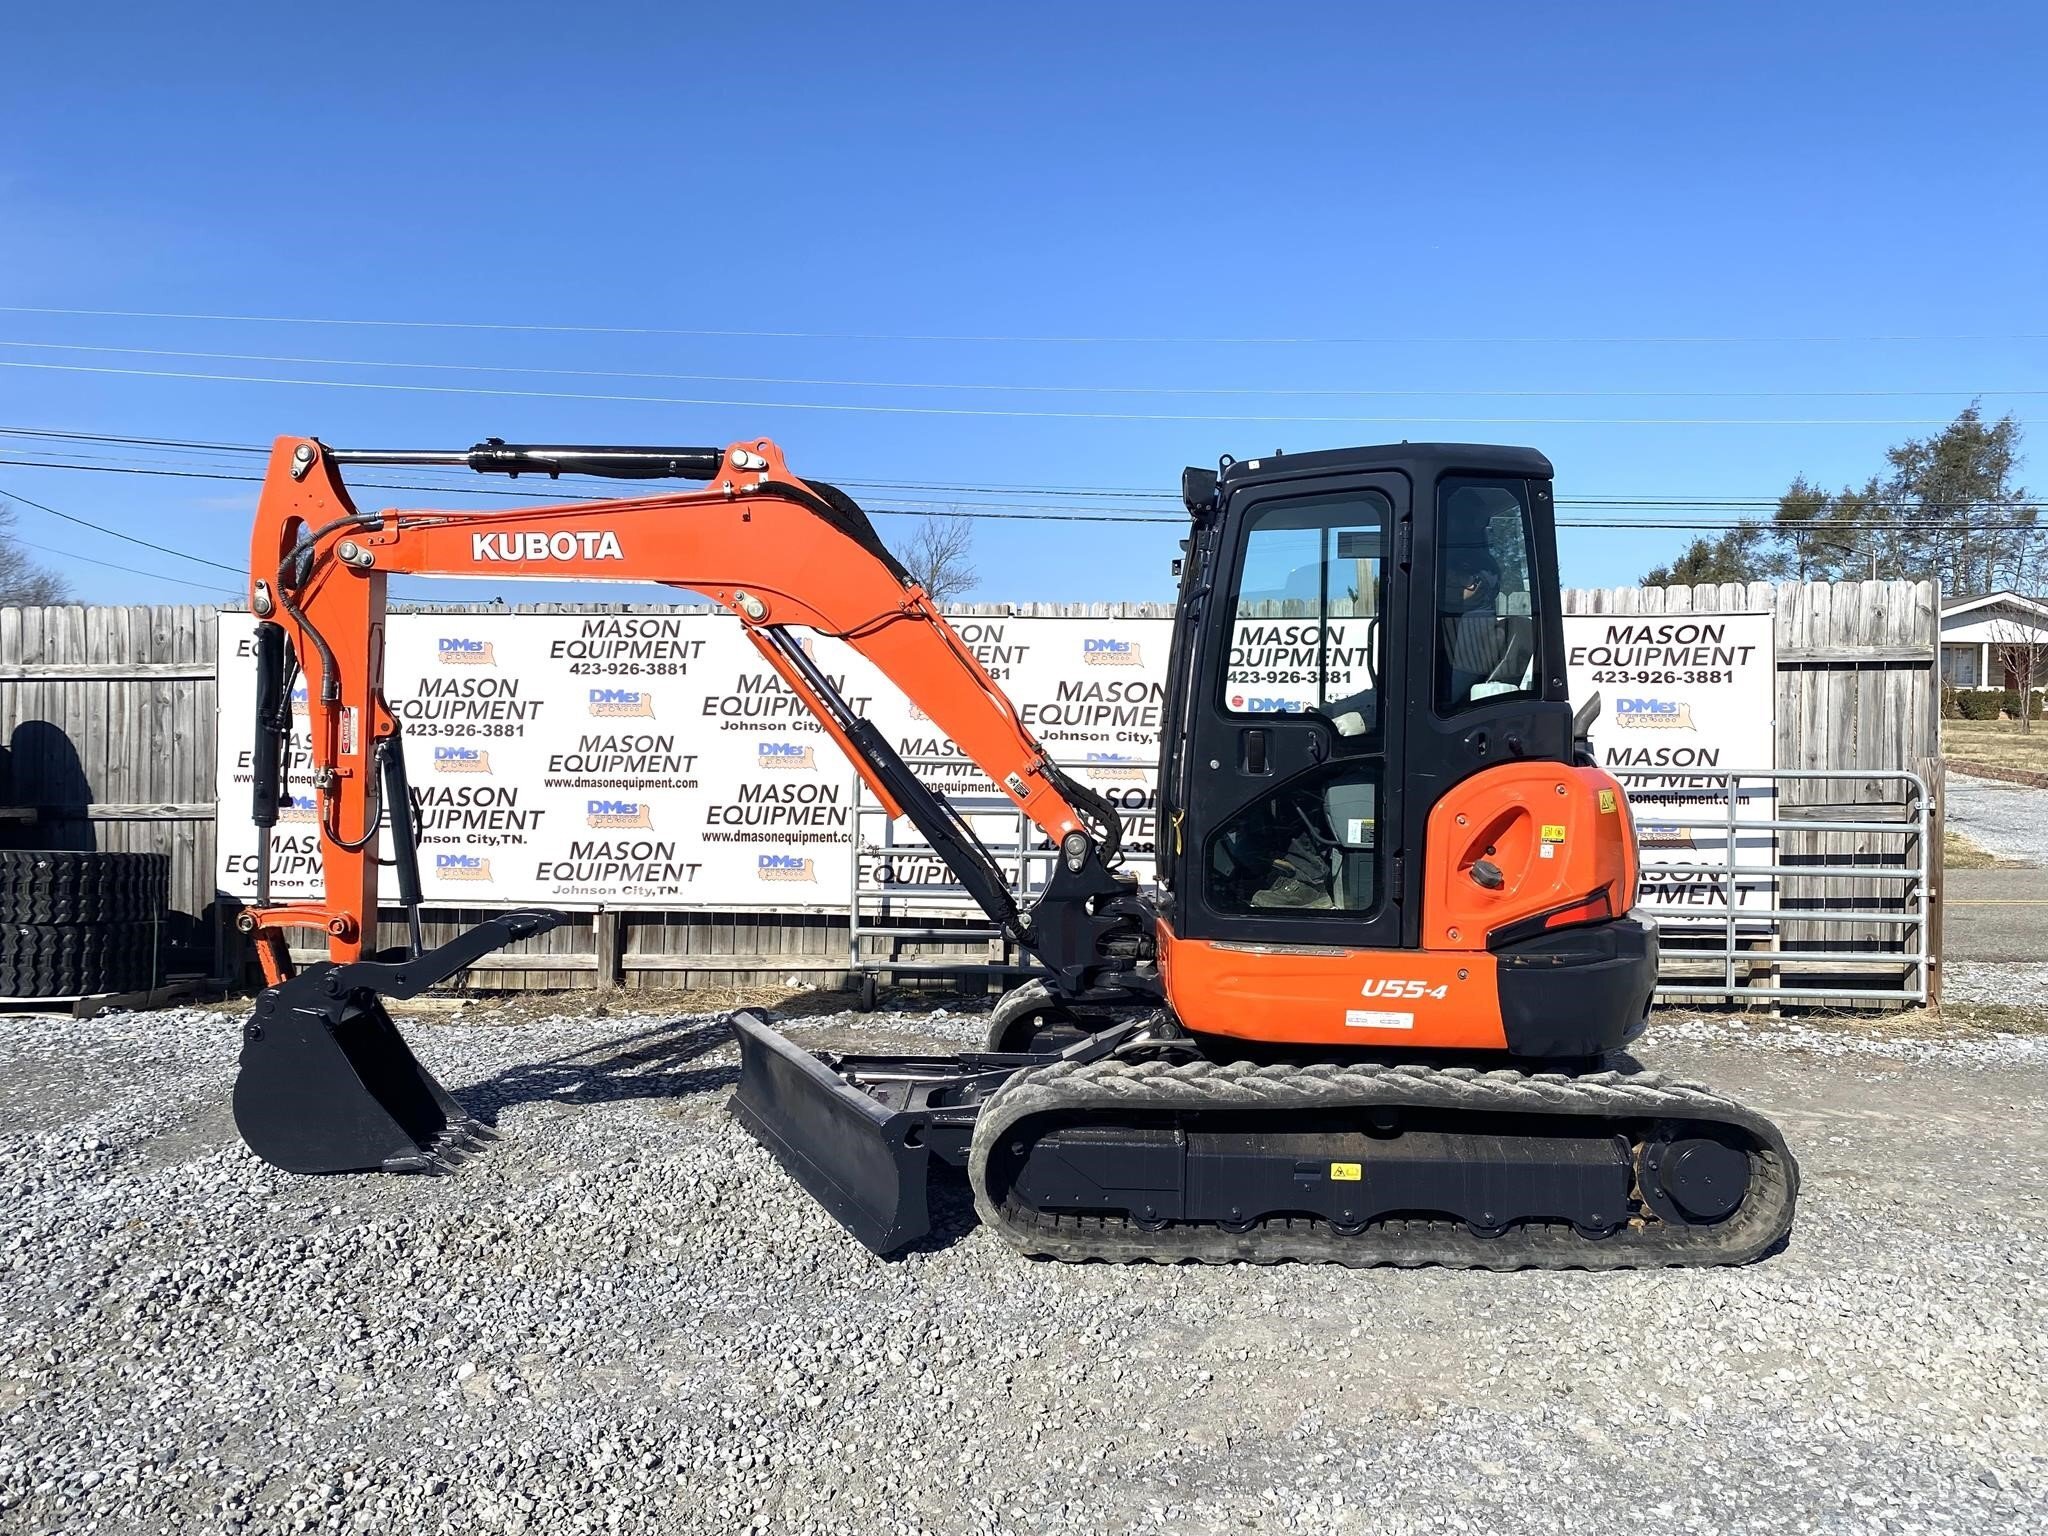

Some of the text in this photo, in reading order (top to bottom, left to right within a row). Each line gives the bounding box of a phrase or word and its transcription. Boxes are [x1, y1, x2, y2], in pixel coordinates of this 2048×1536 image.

[472, 531, 624, 561] KUBOTA
[581, 619, 681, 638] MASON
[1239, 626, 1345, 645] MASON
[1605, 624, 1725, 644] MASON
[550, 640, 706, 659] EQUIPMENT
[1228, 648, 1368, 667] QUIPMNT
[1568, 646, 1756, 667] EQUIPMENT
[569, 663, 687, 675] 423-926-3881
[1227, 671, 1351, 684] 423-926-381
[1591, 670, 1733, 684] 423-926-3881
[418, 678, 519, 698] MASON
[736, 674, 845, 694] MAN
[1056, 681, 1166, 703] MASON
[389, 699, 544, 720] EQUIPMENT
[702, 696, 872, 717] EQUIPMT
[1021, 704, 1164, 727] EQUIPME
[405, 723, 524, 737] 423-926-3881
[720, 720, 826, 733] Johnson City,
[578, 735, 674, 752] MASON
[1039, 730, 1162, 744] Johnson City,T
[548, 755, 698, 773] EQUIPMENT
[1605, 747, 1720, 767] MASON
[544, 777, 698, 791] www.dmasonequipment.com
[738, 783, 839, 804] MASON
[413, 786, 518, 807] MASON
[379, 809, 545, 830] EUIPMENT
[706, 805, 853, 826] EQUIPMEN
[466, 834, 528, 846] City,TN.
[702, 829, 864, 846] www.dmasonequipment.c
[569, 841, 676, 861] MASON
[536, 862, 702, 882] EQUIPMENT
[243, 877, 304, 888] Jonson
[552, 885, 684, 898] Johnson City,TN.
[1361, 979, 1449, 999] U55-4
